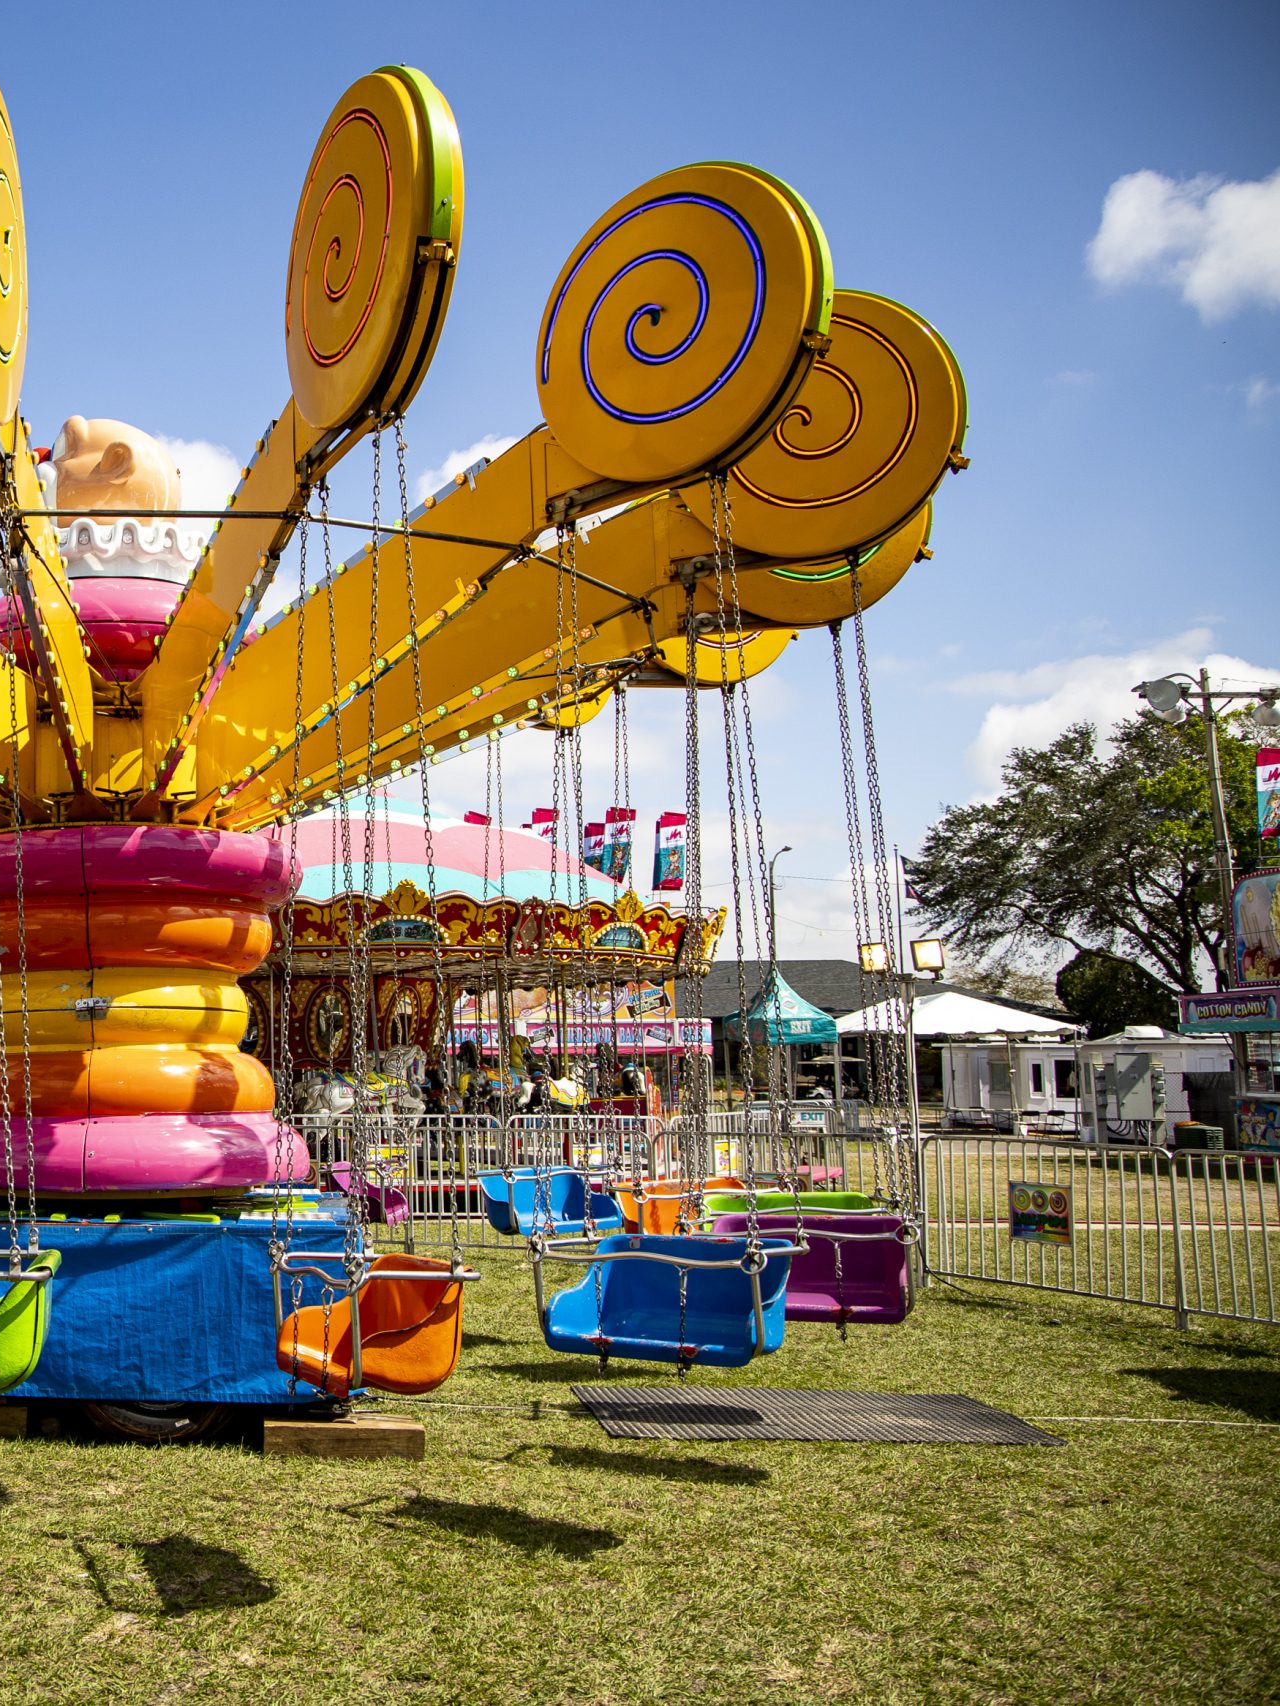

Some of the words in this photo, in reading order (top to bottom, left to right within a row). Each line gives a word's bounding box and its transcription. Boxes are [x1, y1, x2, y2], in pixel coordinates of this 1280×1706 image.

[1197, 1003, 1232, 1018] COTTON
[1234, 1001, 1267, 1016] CANDY
[790, 1020, 811, 1033] EXIT
[801, 1112, 824, 1121] EXIT
